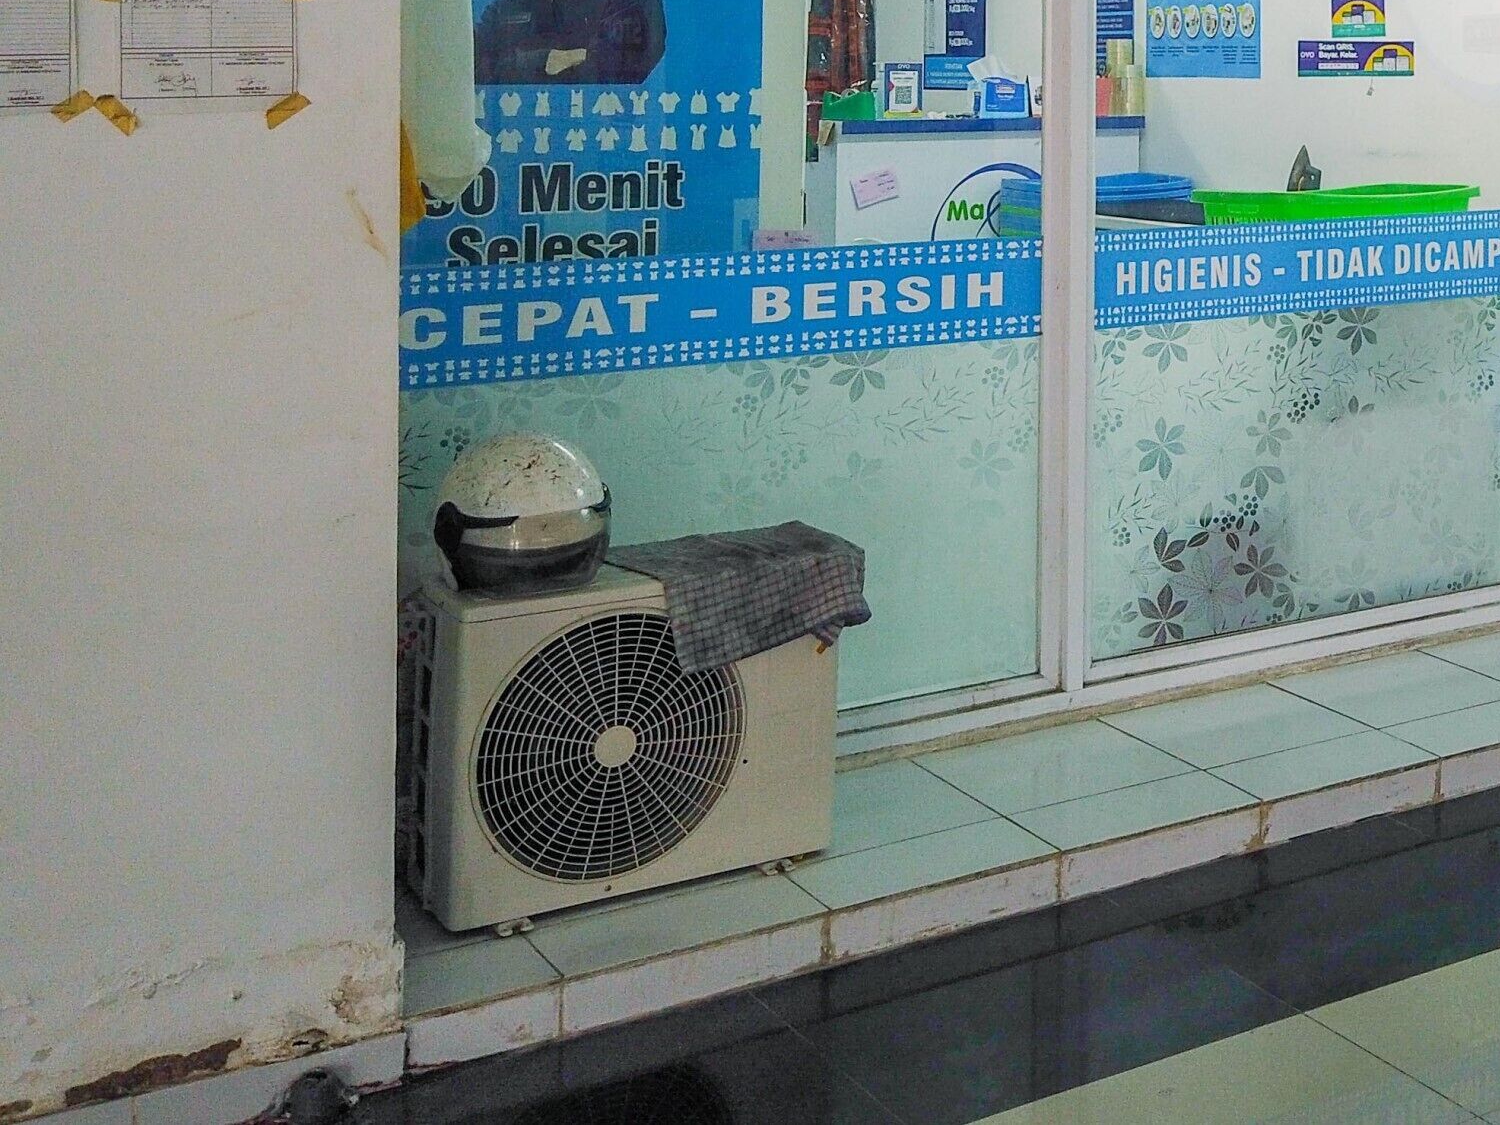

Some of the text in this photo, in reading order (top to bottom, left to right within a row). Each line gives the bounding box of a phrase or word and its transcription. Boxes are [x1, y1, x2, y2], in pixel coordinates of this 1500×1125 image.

[519, 160, 686, 215] Menit
[446, 217, 660, 269] Selesai
[1115, 252, 1263, 296] HIGIENIS
[1297, 245, 1384, 282] TIDAK
[400, 293, 660, 350] CEPAT
[751, 271, 1005, 324] BERSIH
